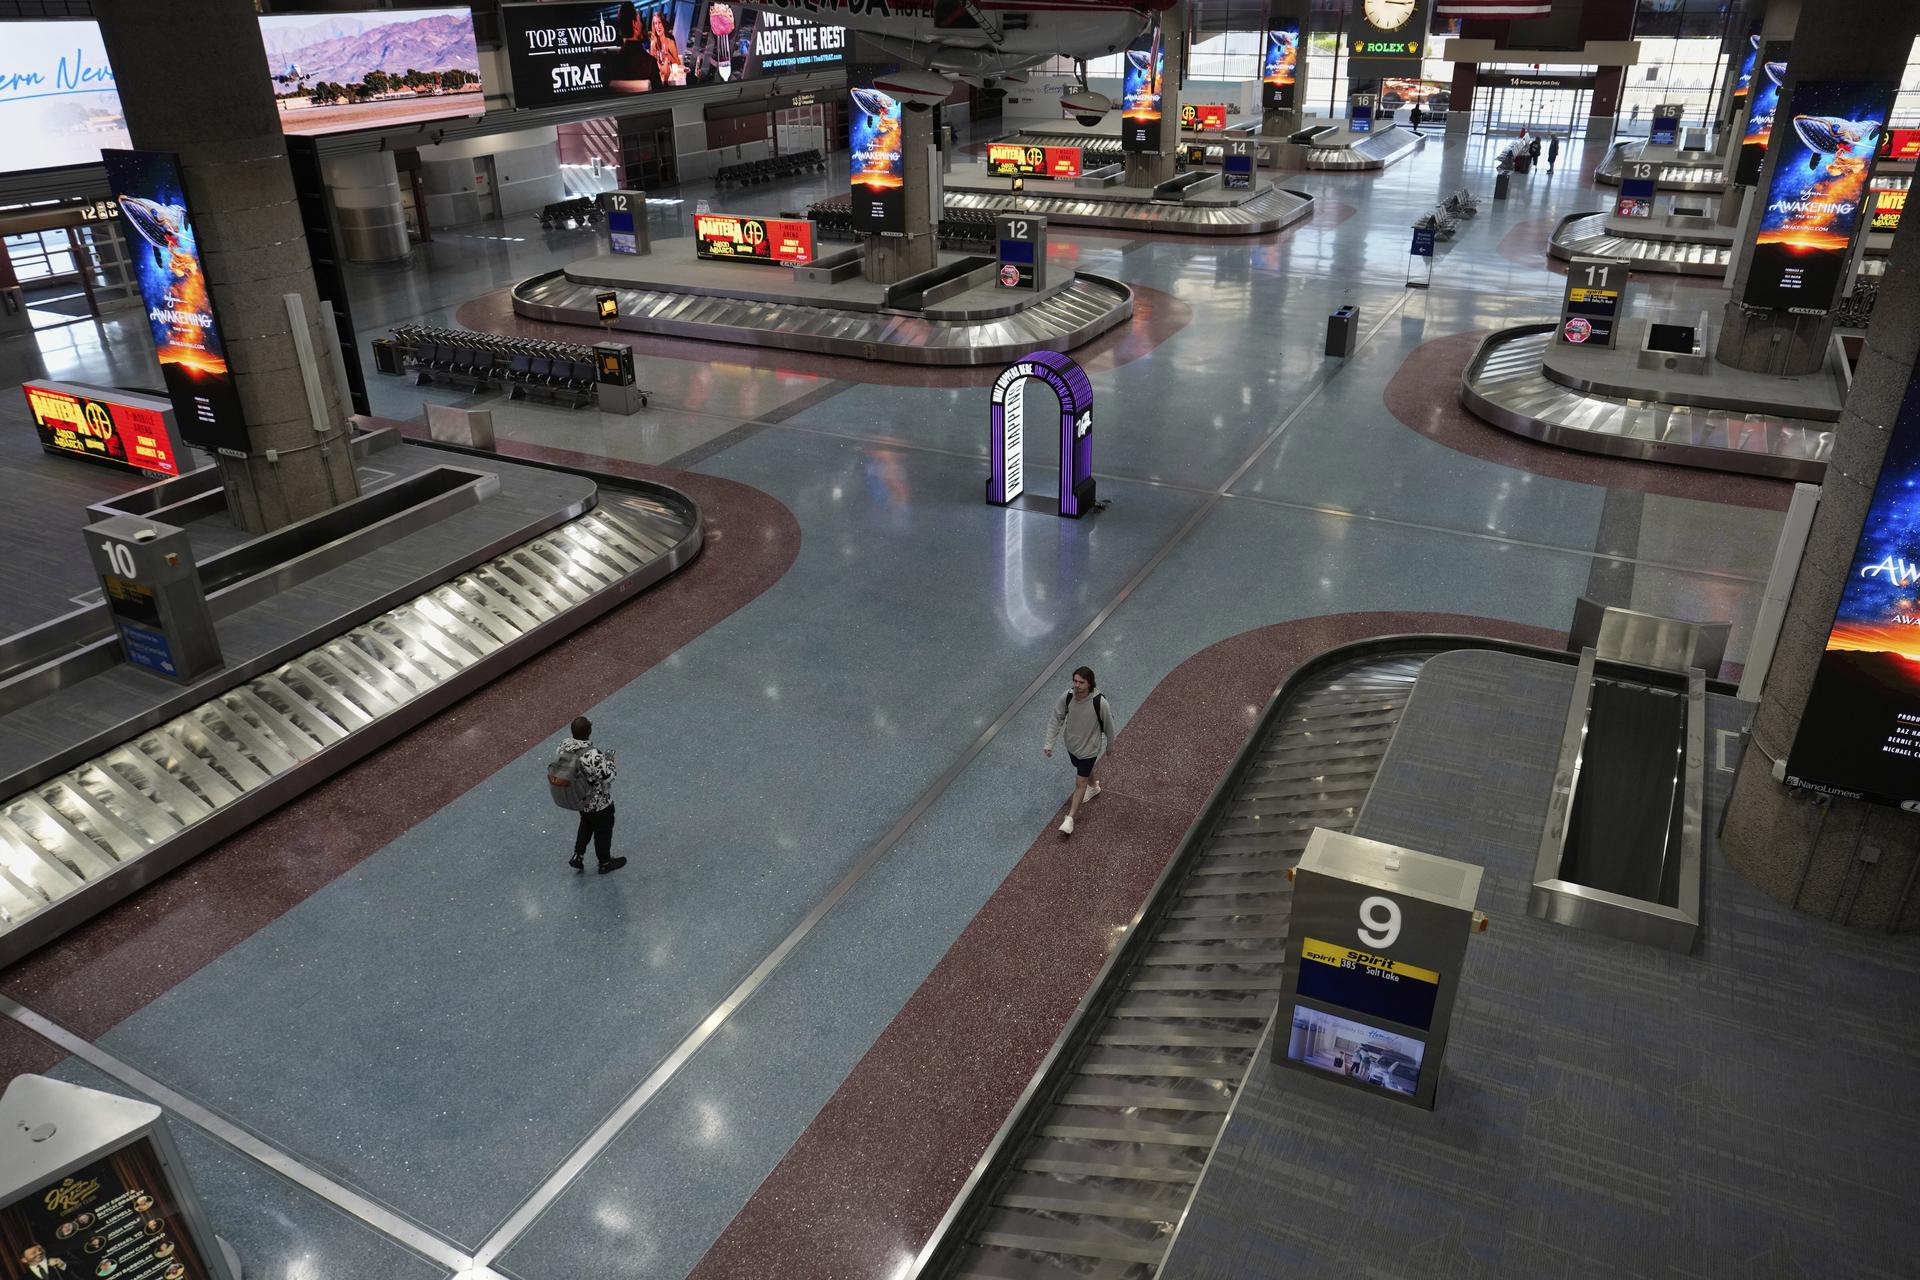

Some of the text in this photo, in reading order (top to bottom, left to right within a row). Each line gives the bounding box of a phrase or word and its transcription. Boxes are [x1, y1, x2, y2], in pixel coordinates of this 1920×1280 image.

[526, 29, 556, 48] TOP
[567, 25, 616, 44] WORLD
[756, 26, 846, 55] ABOVE THE REST
[1367, 43, 1404, 52] ROLEX
[552, 63, 601, 88] STRAT
[1511, 78, 1519, 86] 14
[1358, 96, 1369, 106] 16
[1662, 106, 1676, 117] 15
[1232, 142, 1246, 155] 14
[1633, 164, 1651, 178] 13
[612, 195, 628, 211] 12
[1768, 199, 1854, 215] AWAKENING
[82, 207, 97, 219] 12
[698, 219, 744, 243] PANTERA
[1008, 221, 1028, 239] 12
[1585, 266, 1609, 287] 11
[150, 307, 212, 328] AWAKENING
[1046, 372, 1069, 397] HAPPENS
[29, 394, 92, 436] PANTERA
[1007, 383, 1022, 494] WHAT HAPPENS
[101, 541, 137, 579] 10
[1896, 727, 1910, 735] BAZ
[1888, 736, 1912, 746] BERNIE
[1882, 745, 1911, 756] MICHAEL
[1799, 780, 1860, 799] NanoLumens
[1358, 896, 1401, 949] 9
[1306, 951, 1337, 964] spirit
[1347, 950, 1396, 969] spirit
[1341, 959, 1400, 982] 385 Salt Lake
